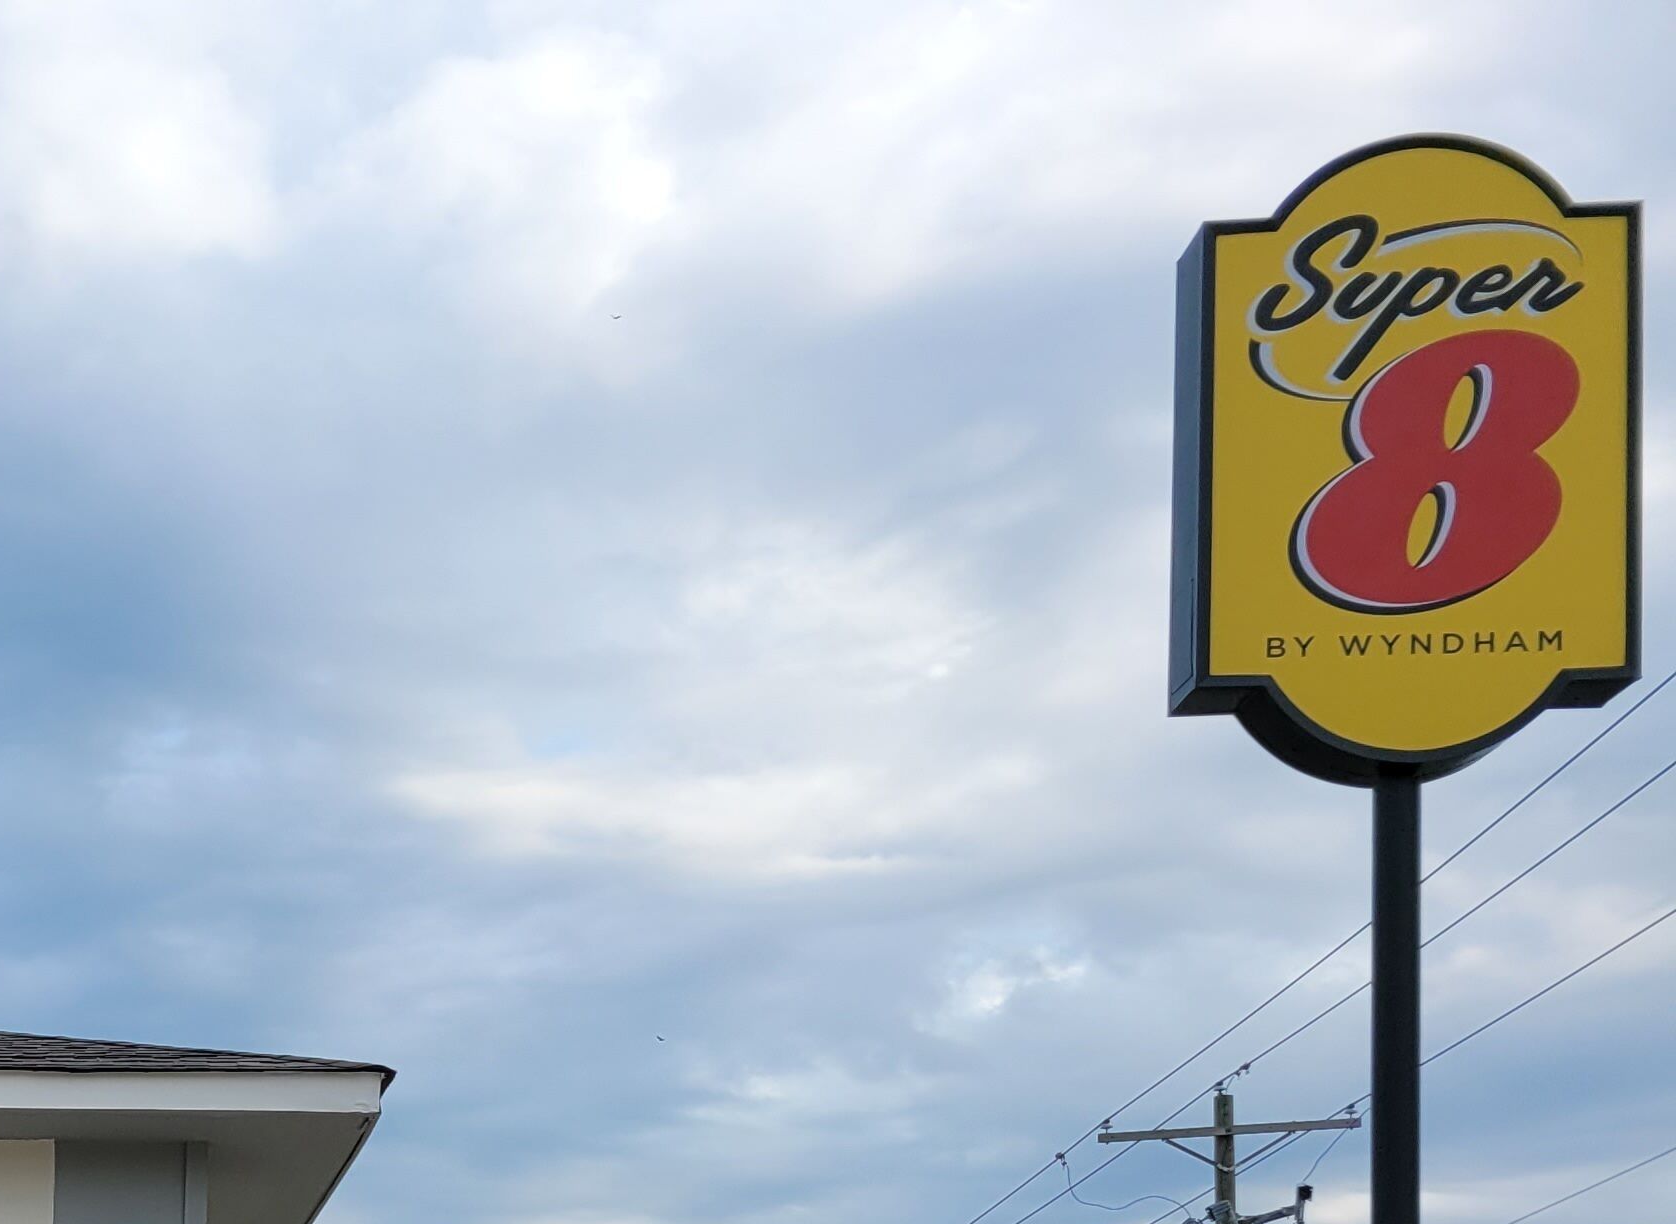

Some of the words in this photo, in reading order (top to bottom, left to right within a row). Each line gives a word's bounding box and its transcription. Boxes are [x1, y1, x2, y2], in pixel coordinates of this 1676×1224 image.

[1251, 214, 1583, 382] Super
[1288, 329, 1580, 615] 8
[1266, 636, 1315, 658] BY
[1339, 630, 1563, 657] WYNDHAM
